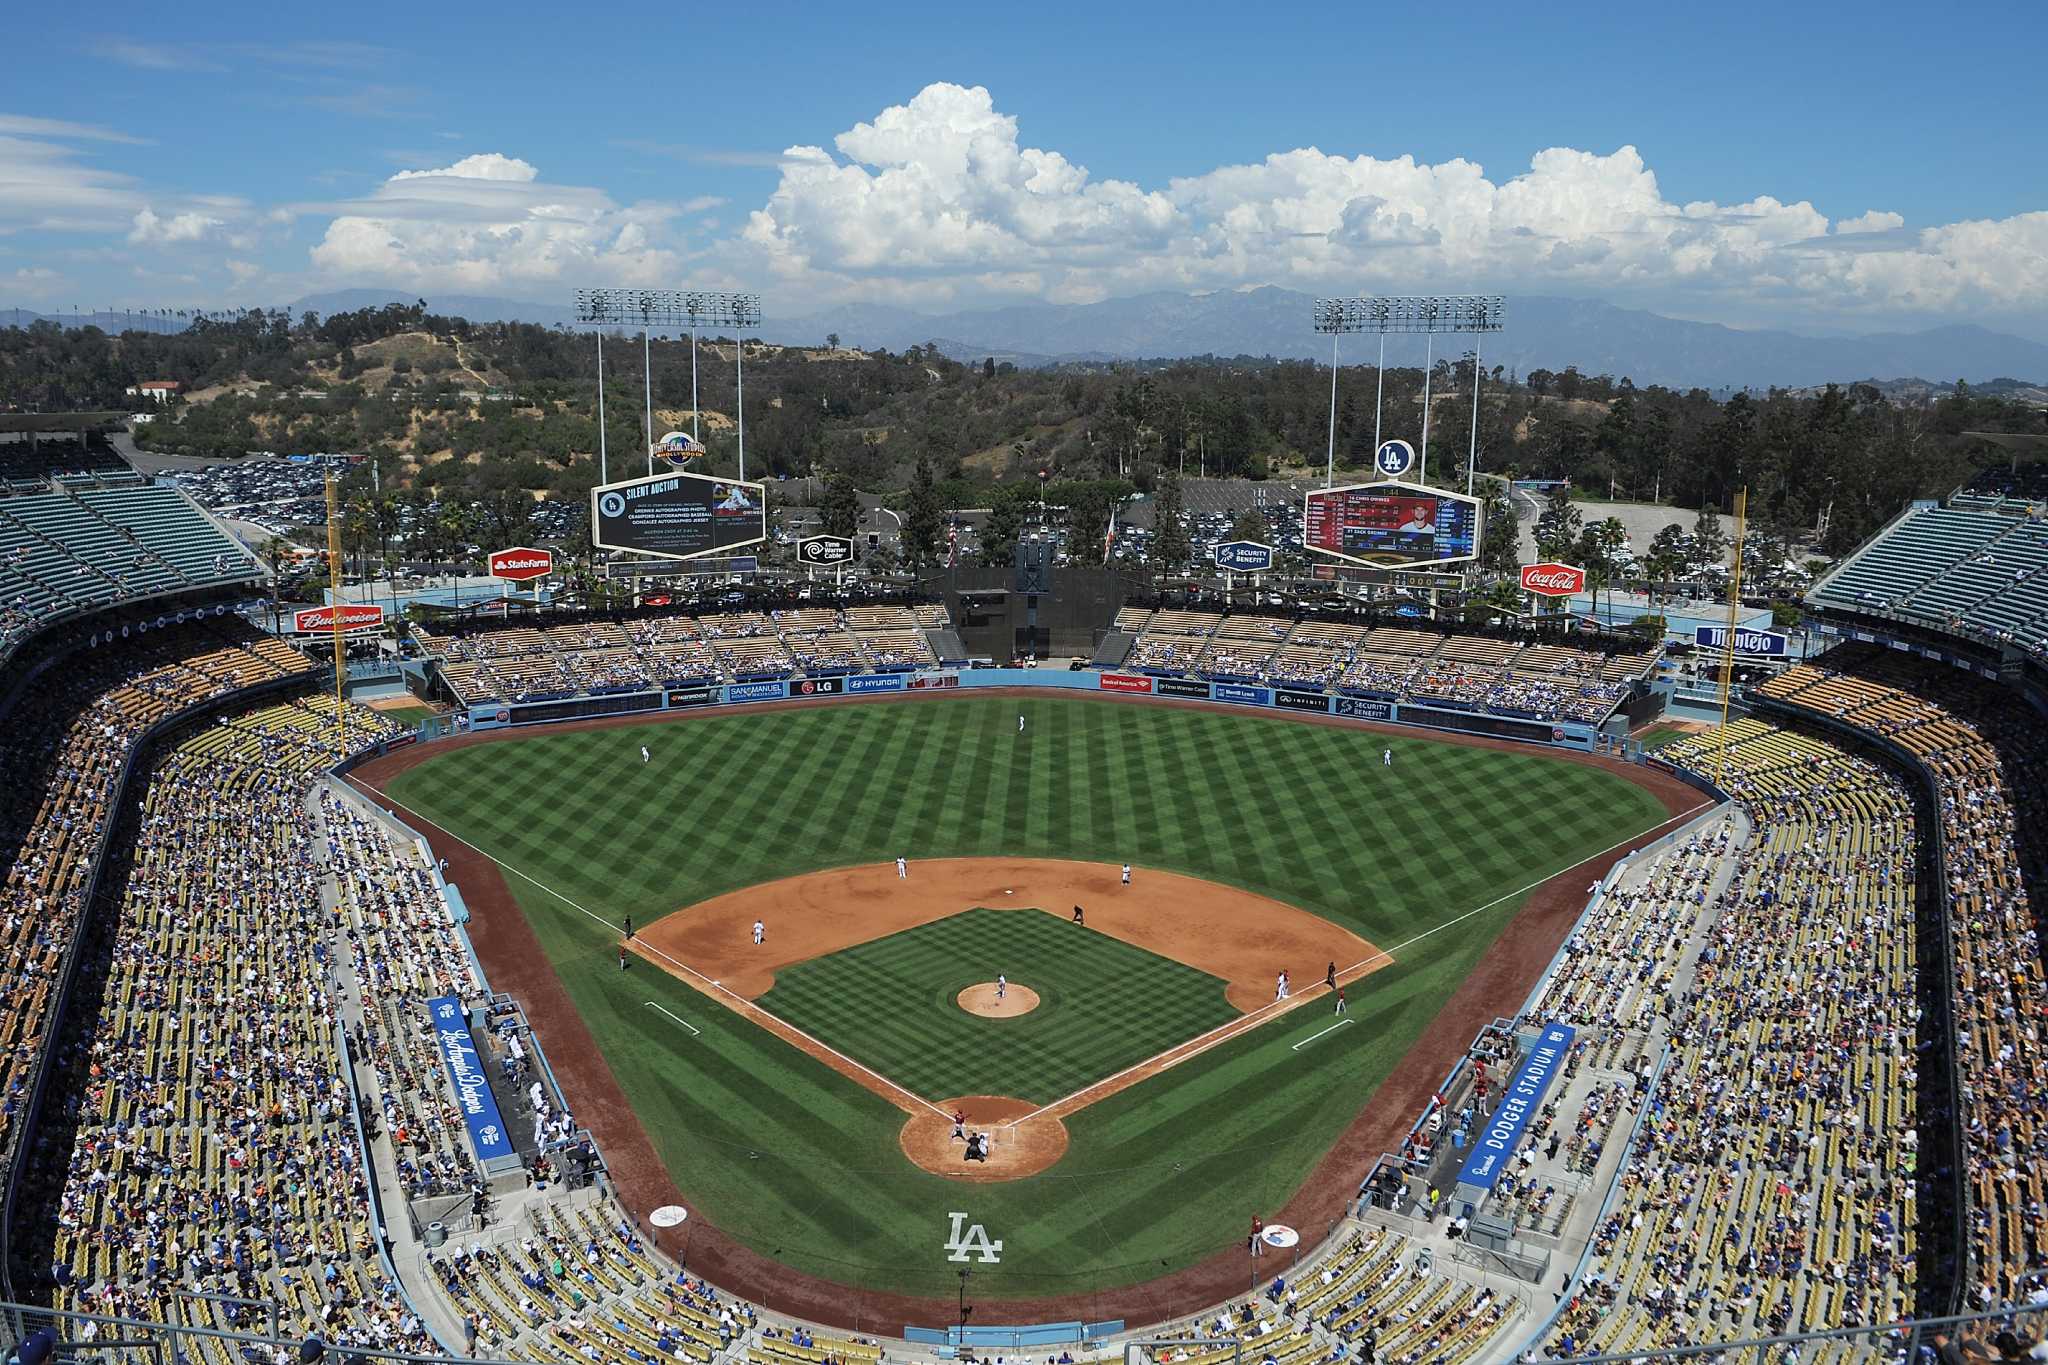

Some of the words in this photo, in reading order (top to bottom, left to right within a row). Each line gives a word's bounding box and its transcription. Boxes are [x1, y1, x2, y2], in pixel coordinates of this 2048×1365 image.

[651, 443, 684, 453] UNIVERSAL
[684, 442, 706, 453] STUDIOS
[1384, 445, 1401, 470] LA
[627, 484, 649, 500] SILENT
[651, 479, 679, 495] AUCTION
[1236, 549, 1267, 557] SECURITY
[1236, 555, 1264, 563] BENEFIT
[300, 612, 380, 628] Budweiser
[816, 682, 832, 692] LG
[865, 678, 900, 687] HYUNDAI
[730, 687, 746, 696] SAN
[751, 684, 782, 694] MANUEL
[1225, 688, 1241, 696] Merrill
[1293, 697, 1326, 707] INFINITI
[1354, 701, 1388, 711] SECURITY
[1354, 709, 1384, 717] BENEFIT
[445, 1045, 475, 1082] Angeles
[457, 1075, 486, 1114] Dodgers
[1486, 1096, 1529, 1150] DODGER
[1517, 1047, 1557, 1096] STADIUM
[943, 1212, 1003, 1264] LA
